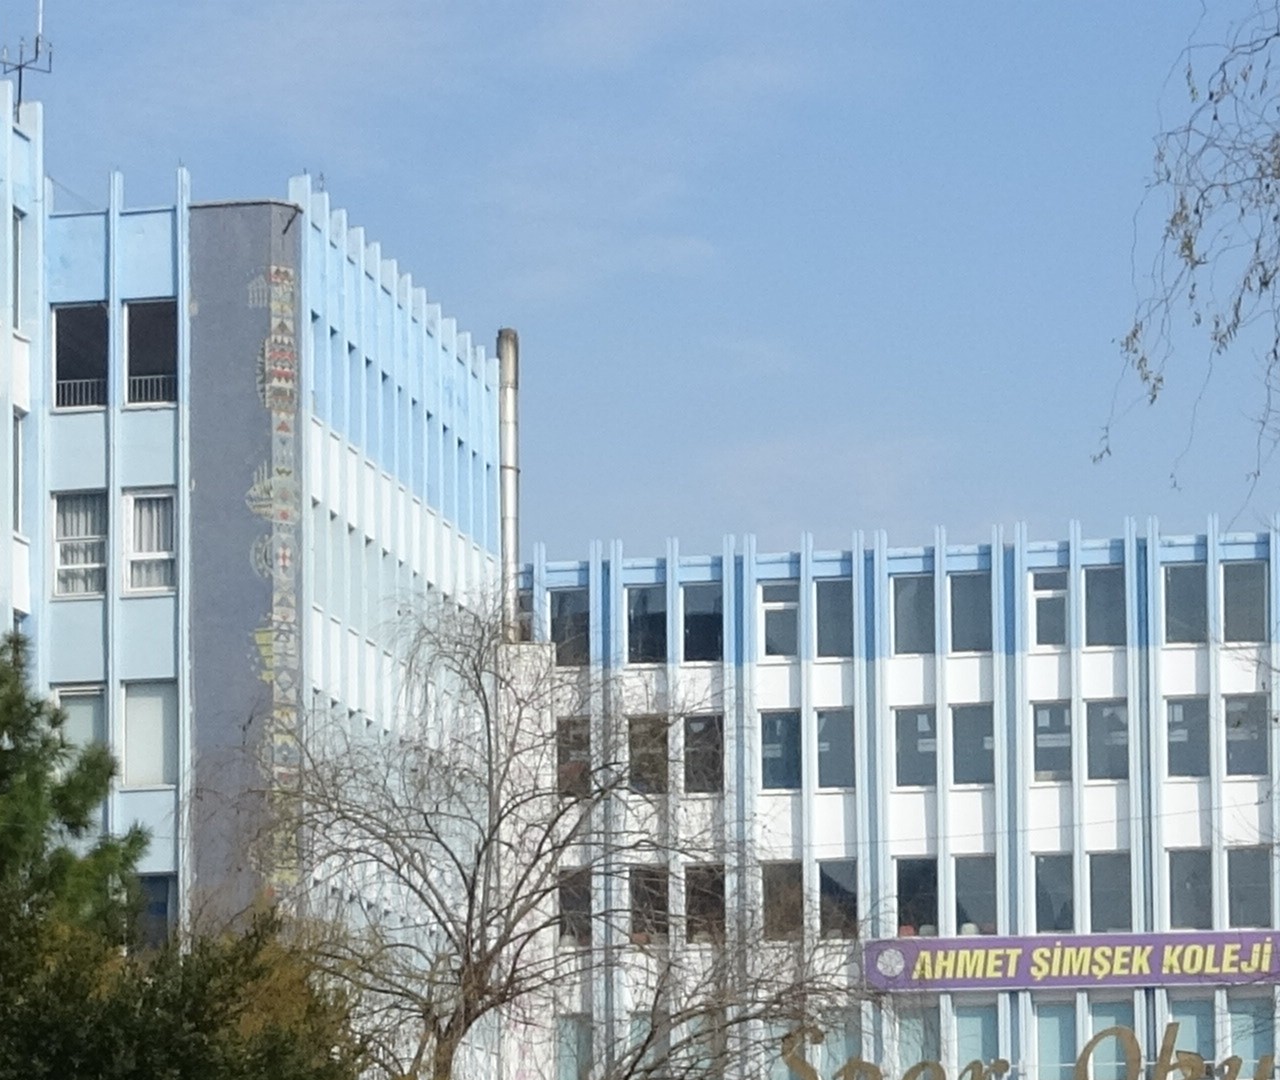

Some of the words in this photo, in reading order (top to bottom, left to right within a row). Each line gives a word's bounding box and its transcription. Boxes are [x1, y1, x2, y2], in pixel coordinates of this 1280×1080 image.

[913, 947, 1023, 980] AHMET
[1030, 941, 1154, 981] ŞİMŞEK
[1161, 937, 1273, 975] KOLEJİ
